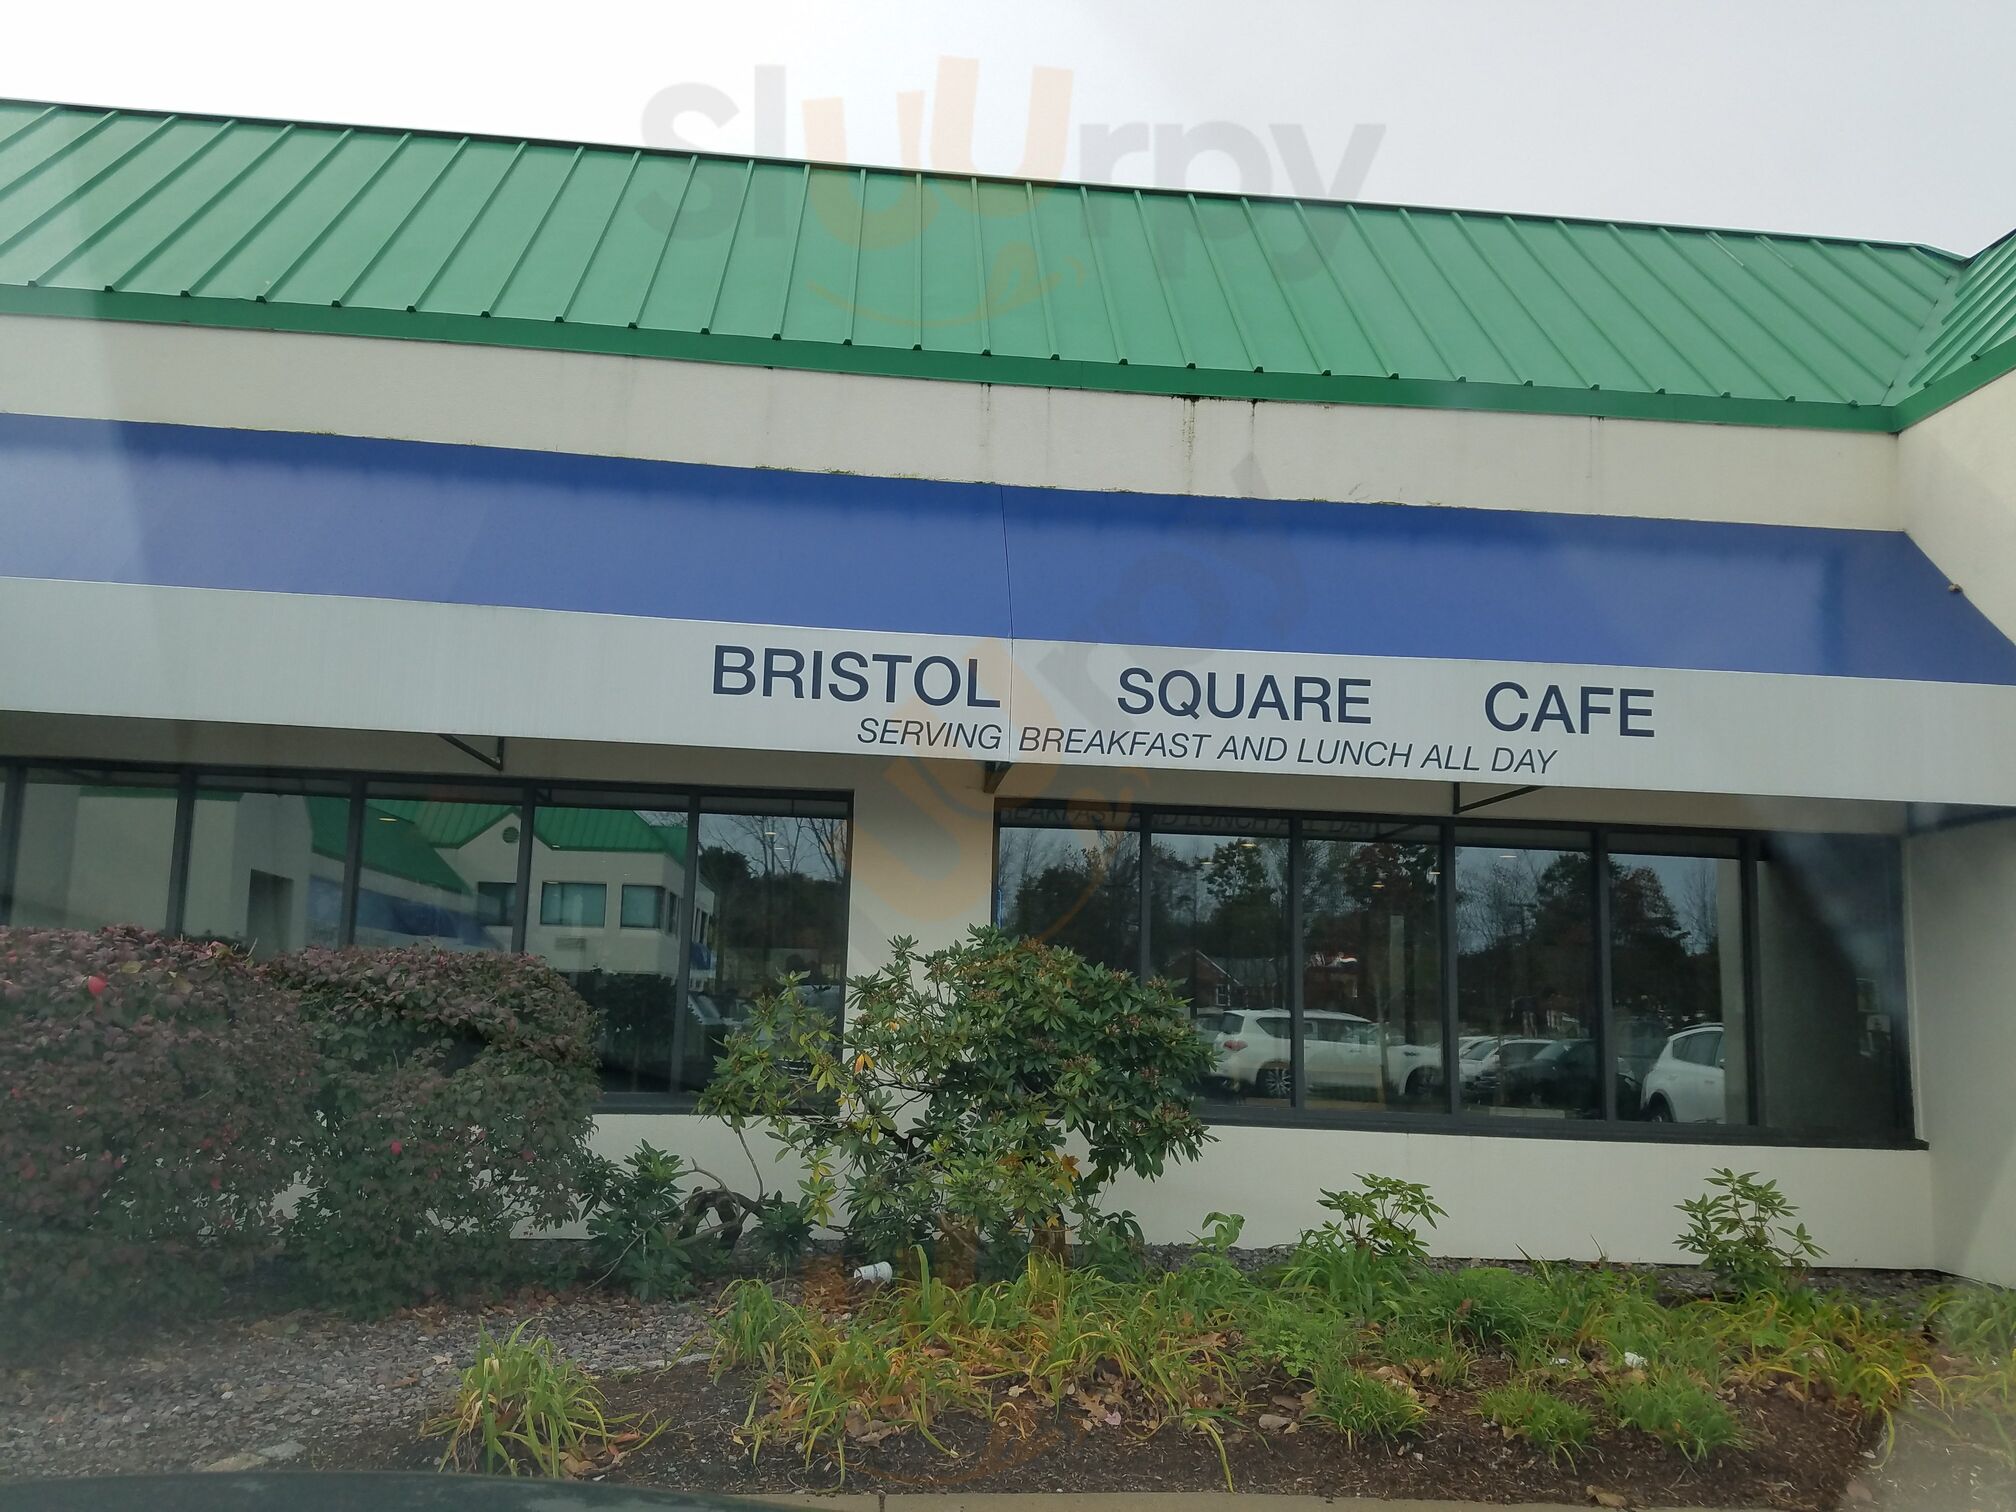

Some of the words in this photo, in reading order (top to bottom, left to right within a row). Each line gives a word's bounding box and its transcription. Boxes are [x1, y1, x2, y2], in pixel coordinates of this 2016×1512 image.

[712, 644, 1001, 709] BRISTOL
[1117, 667, 1372, 725] SQUARE
[1484, 681, 1655, 738] CAFE
[857, 717, 1002, 750] SERVING
[1018, 726, 1212, 759] BREAKFAST
[1216, 735, 1288, 762] AND
[1296, 738, 1413, 768] LUNCH
[1419, 744, 1480, 771] ALL
[1491, 746, 1558, 775] DAY
